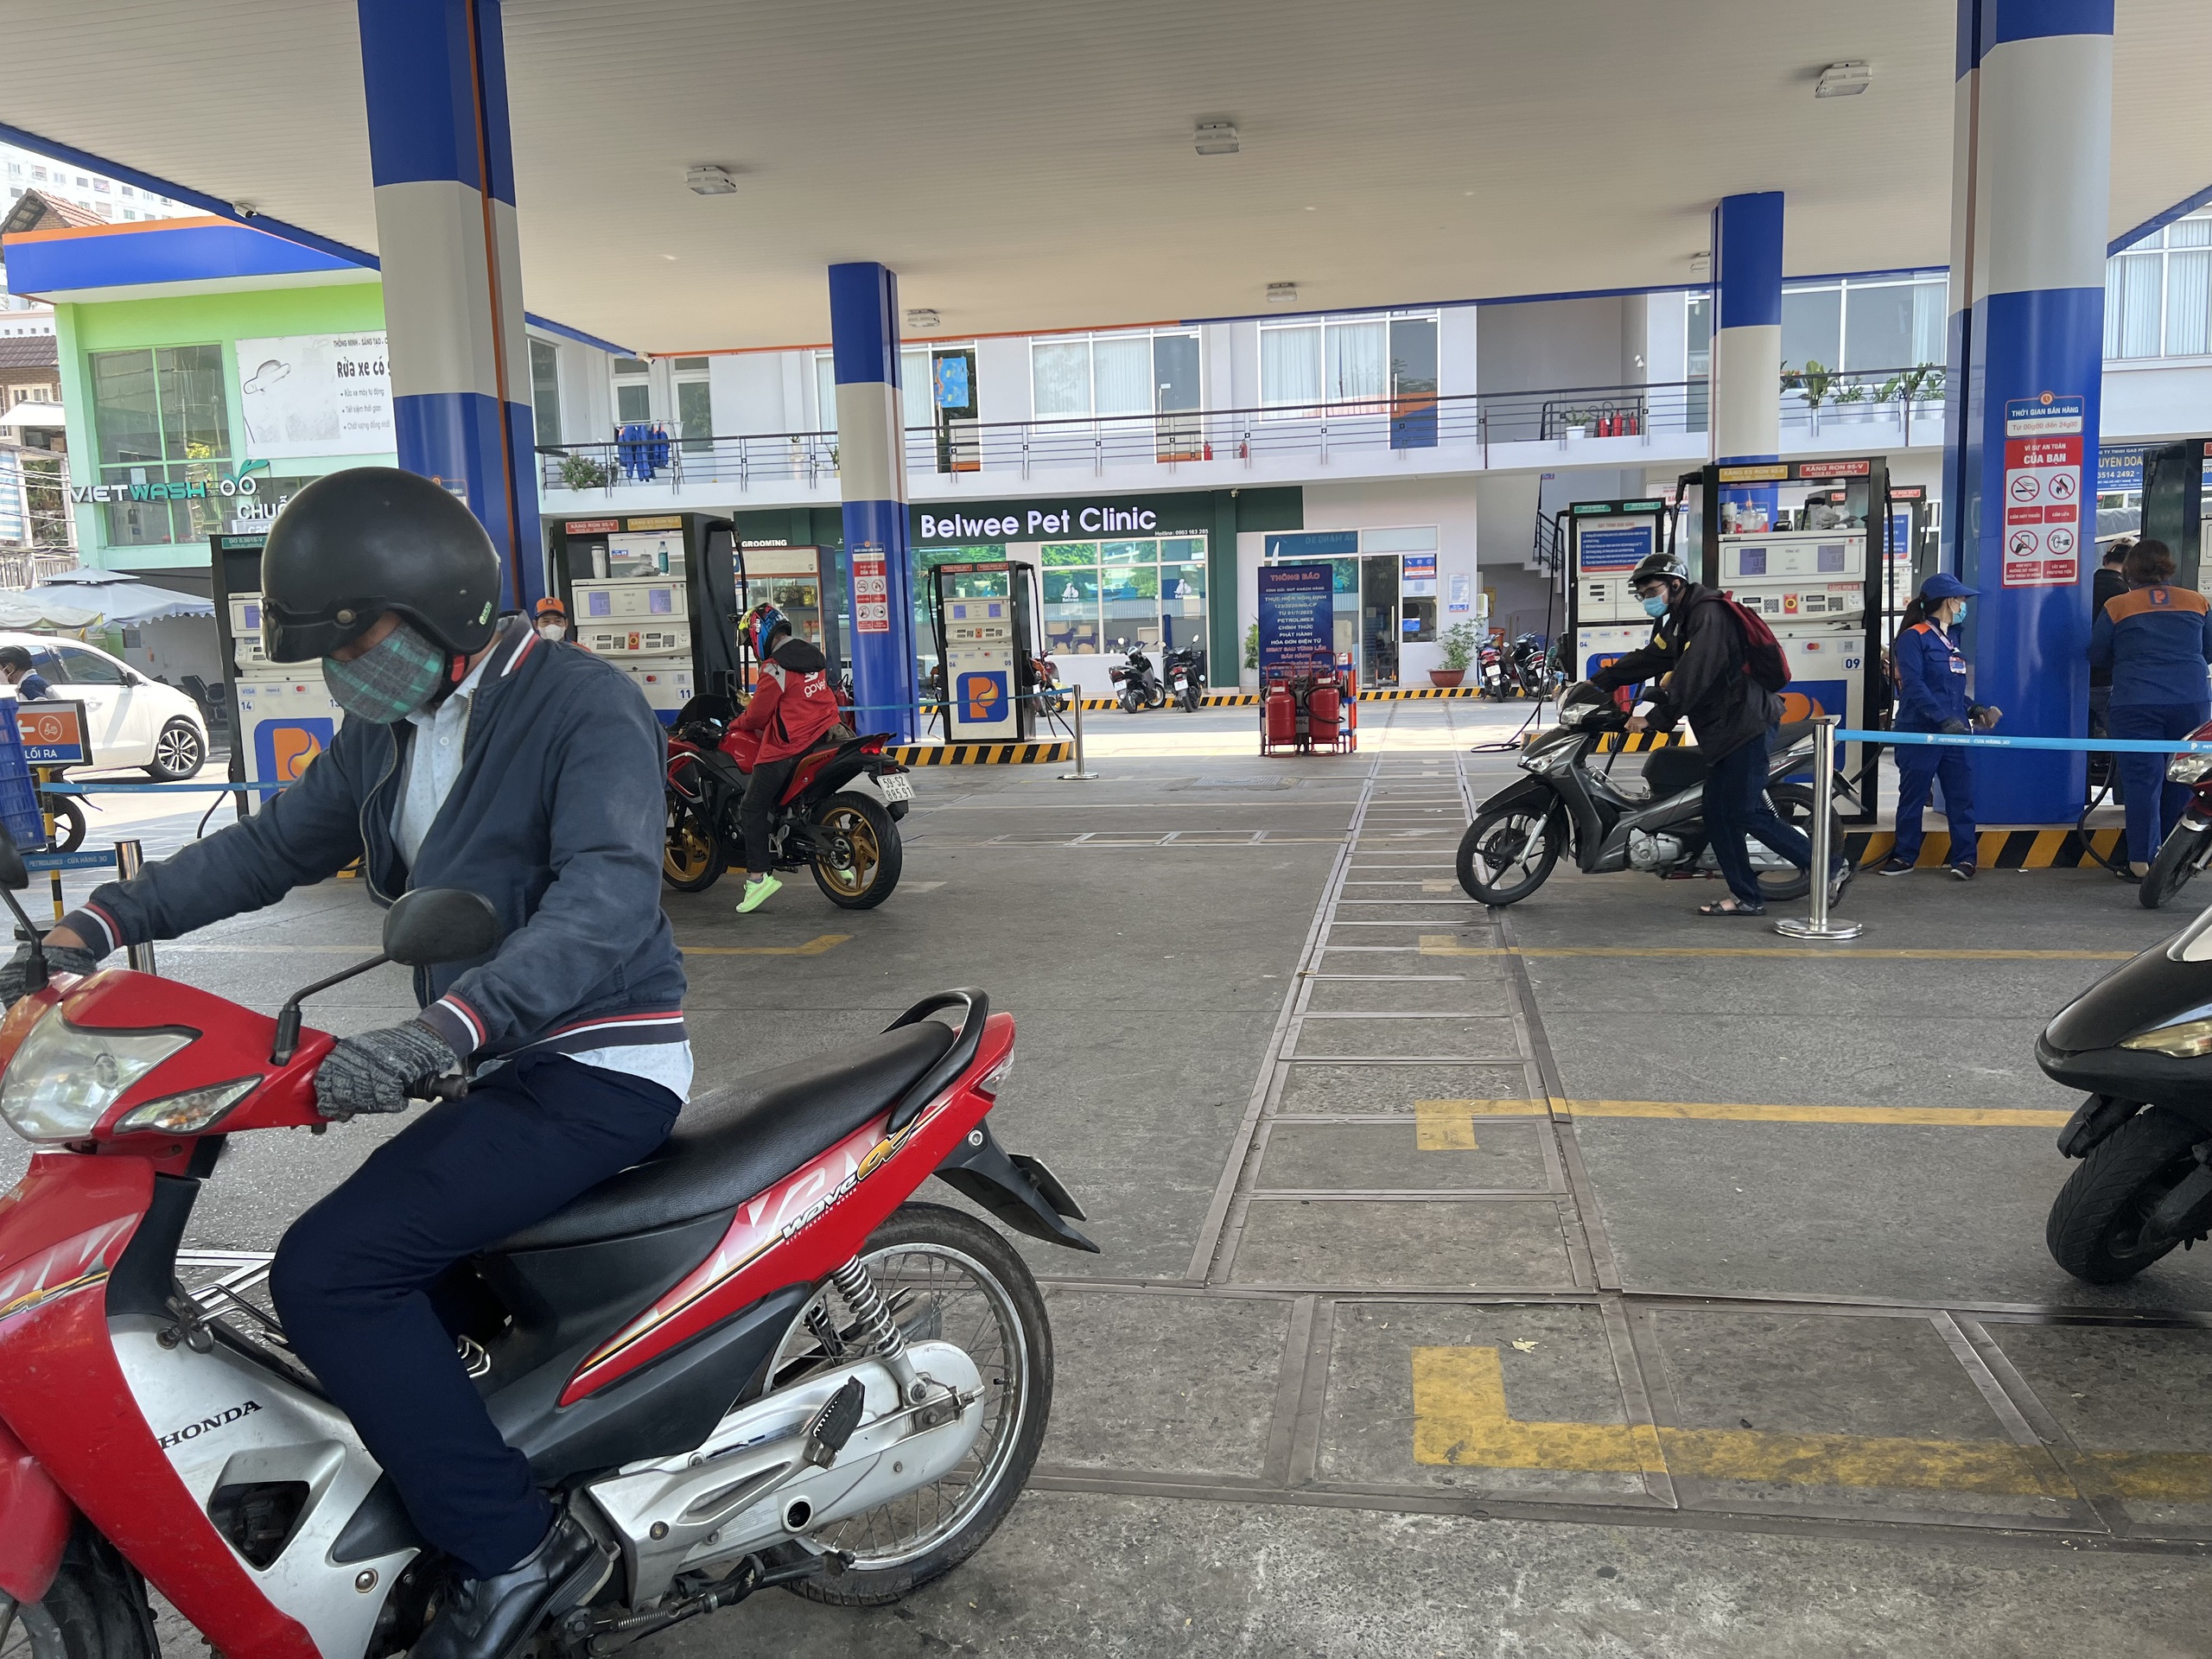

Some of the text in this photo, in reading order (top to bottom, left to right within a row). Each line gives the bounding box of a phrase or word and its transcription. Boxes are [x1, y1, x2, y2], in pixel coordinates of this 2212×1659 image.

[337, 356, 385, 378] Rửa xe có
[2047, 406, 2061, 415] BÁN
[2024, 452, 2067, 465] CỦA BẠN
[71, 480, 207, 503] VIETWASH
[921, 506, 1157, 538] Belwee Pet Clinic
[741, 539, 787, 548] GROOMING
[1270, 572, 1320, 582] THÔNG BÁO
[1846, 659, 1860, 670] 09
[680, 690, 691, 699] 11
[241, 702, 252, 710] 14
[25, 747, 58, 760] LỐI RA
[883, 776, 906, 789] 59-S2
[886, 786, 913, 800] 885.91
[805, 1206, 834, 1231] FASHION
[157, 1400, 263, 1450] HONDA
